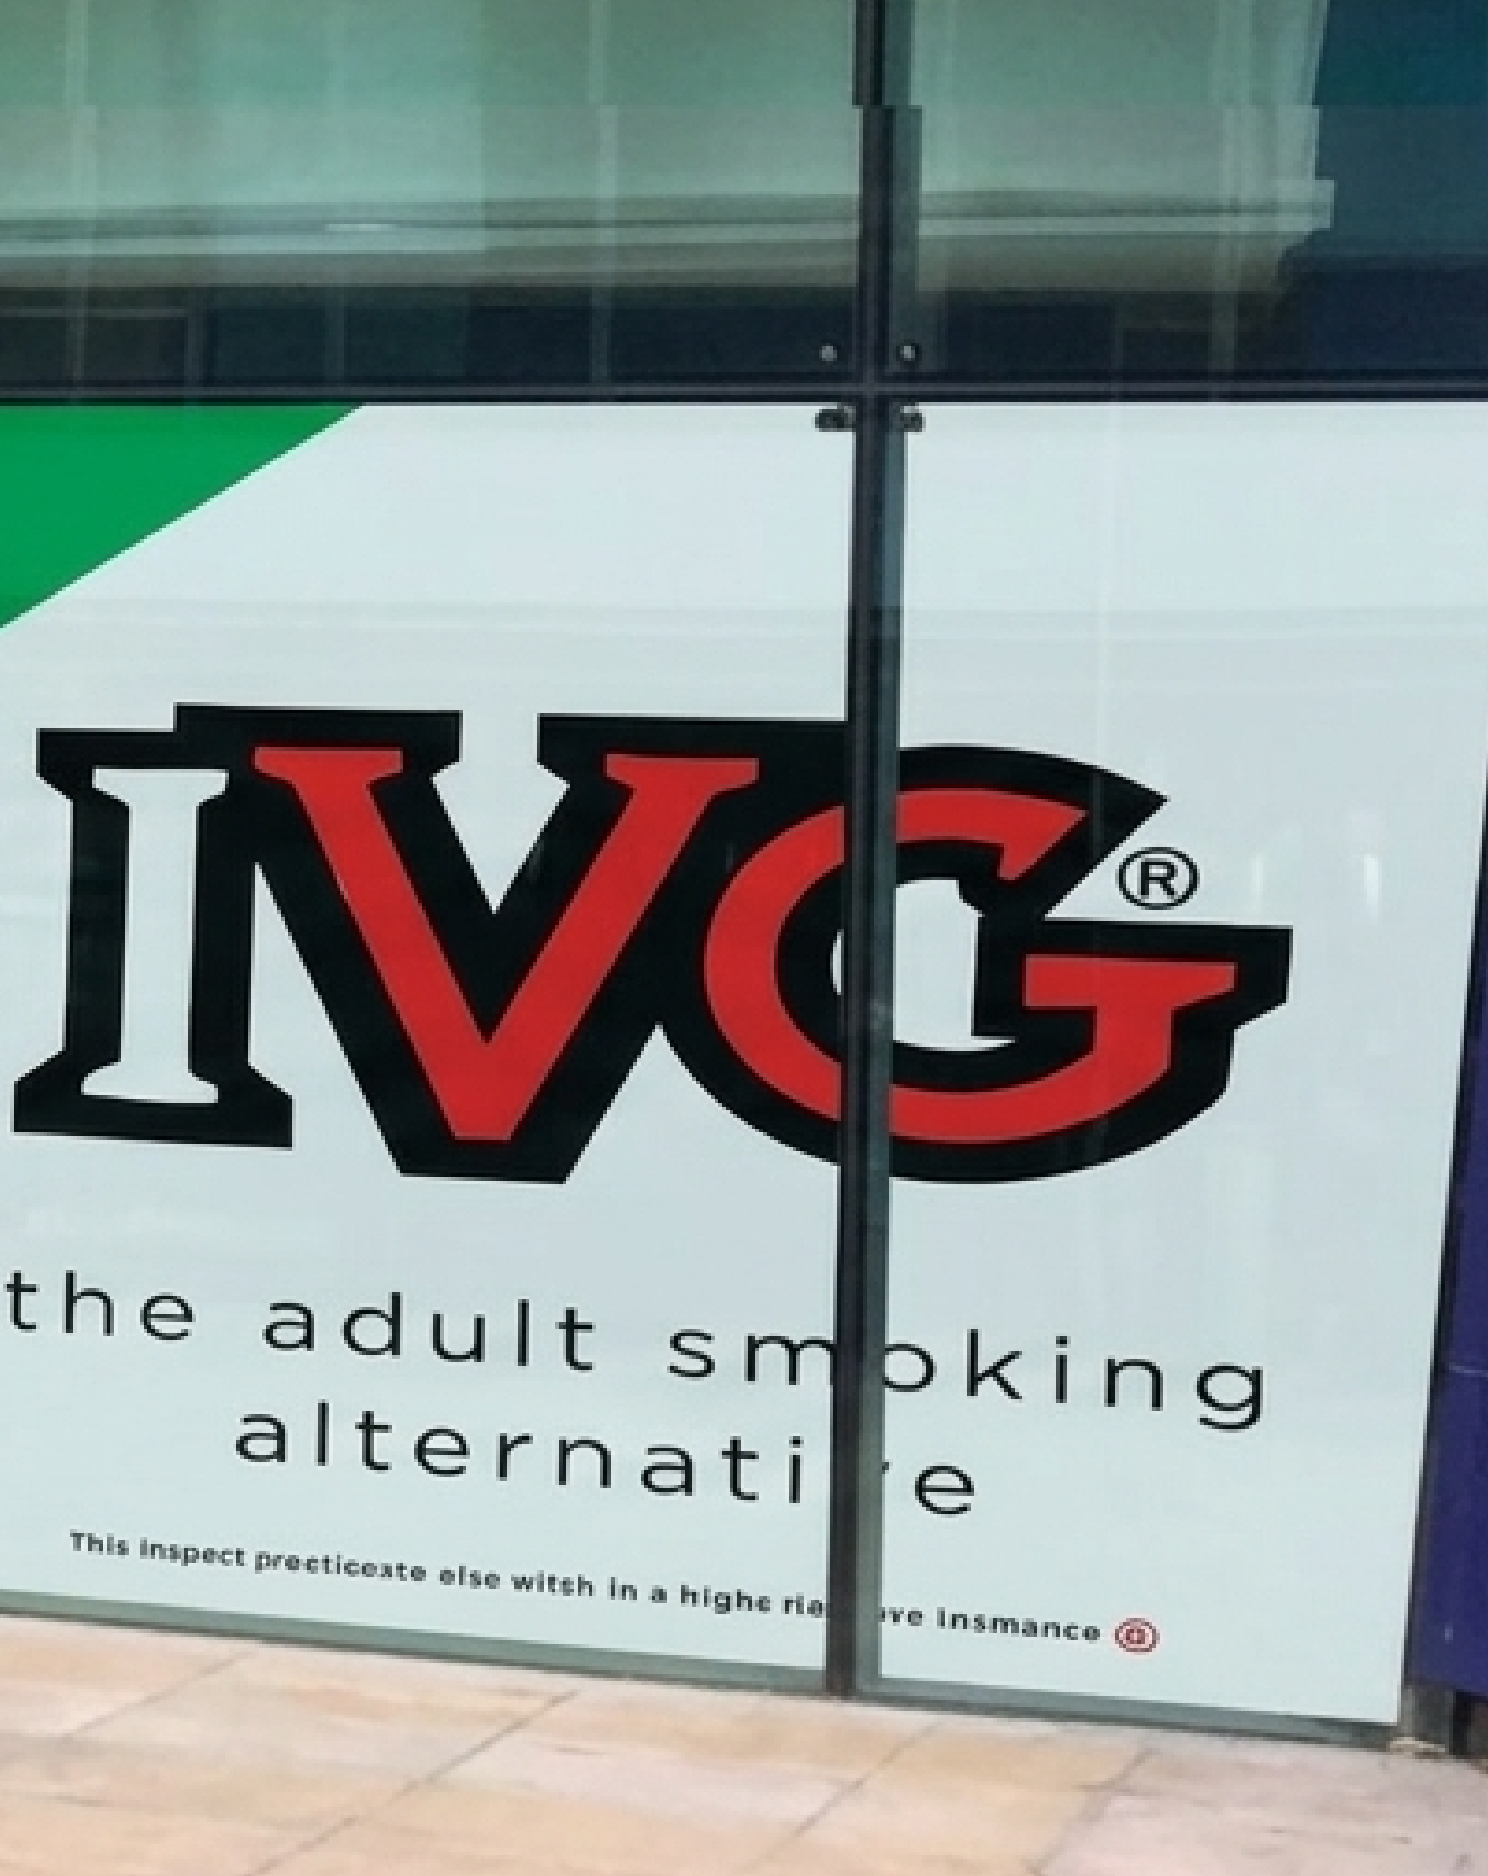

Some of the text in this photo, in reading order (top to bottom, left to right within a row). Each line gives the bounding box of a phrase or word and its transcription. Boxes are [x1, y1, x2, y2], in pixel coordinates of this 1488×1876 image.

[4, 1269, 196, 1340] the
[262, 1291, 596, 1373] adult
[236, 1400, 975, 1517] alternatie
[649, 1584, 668, 1604] a
